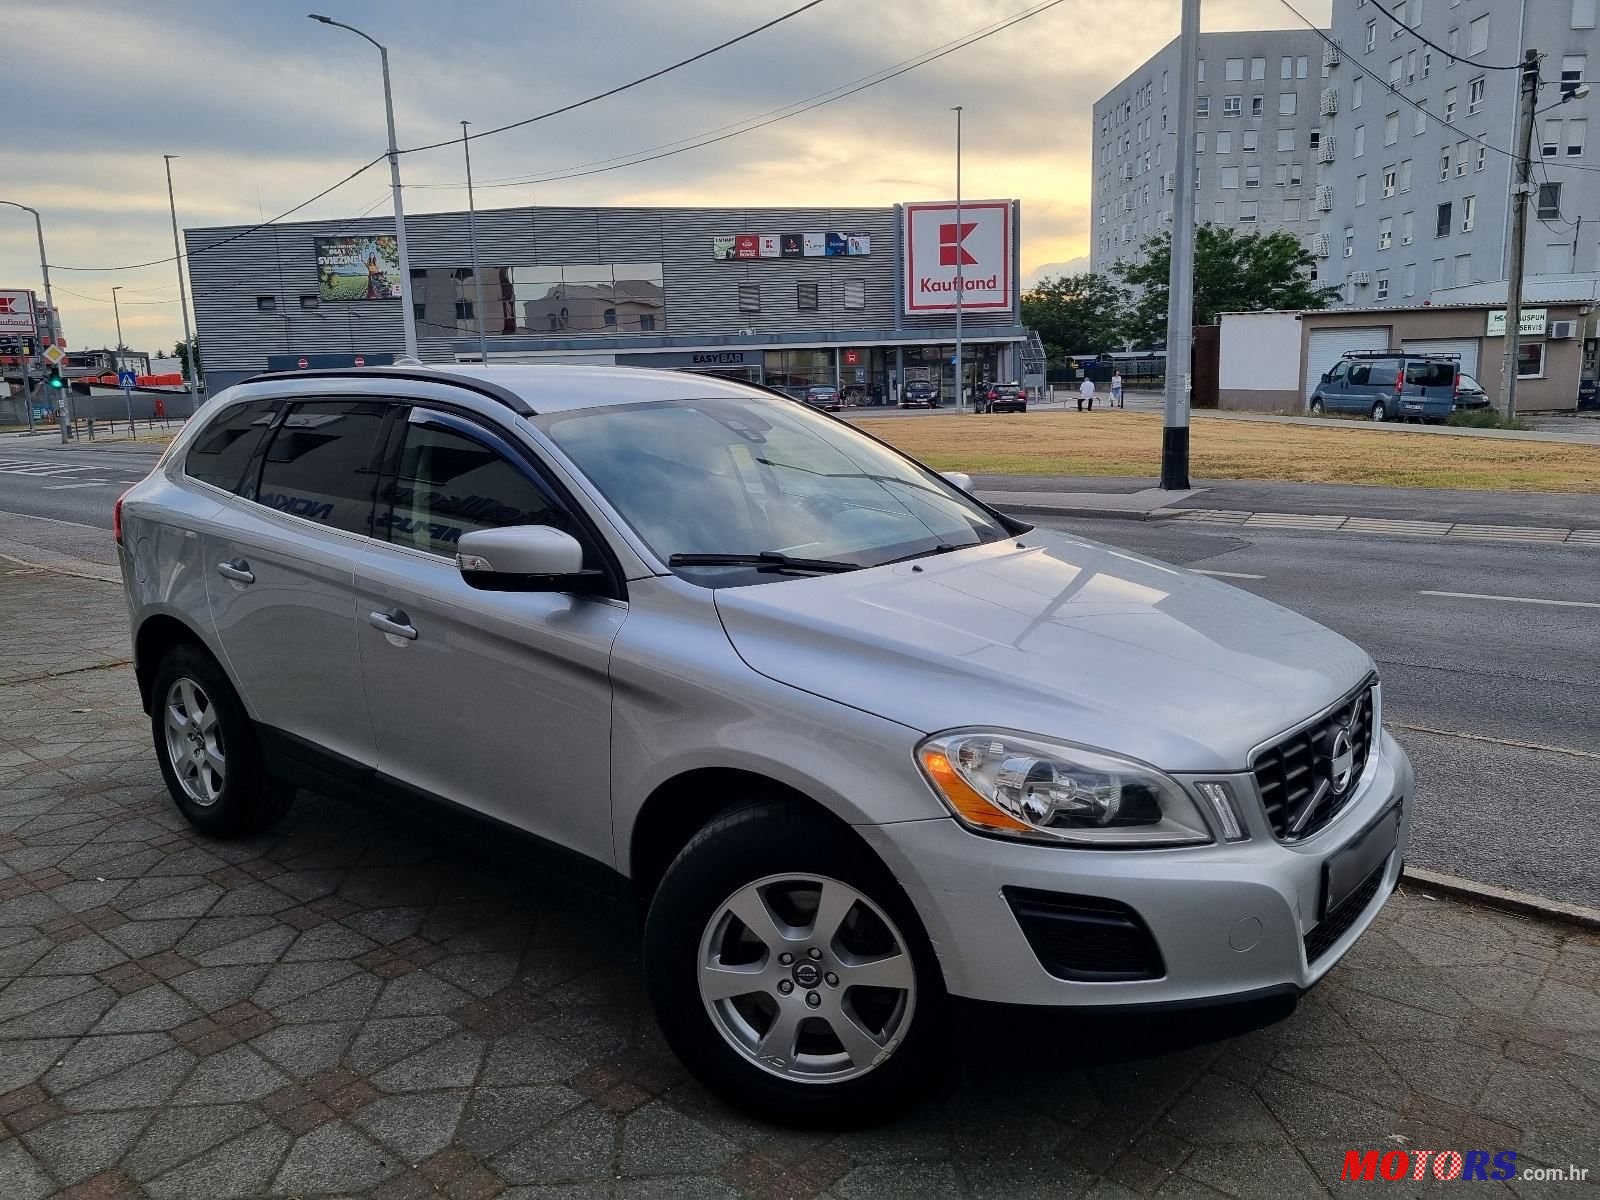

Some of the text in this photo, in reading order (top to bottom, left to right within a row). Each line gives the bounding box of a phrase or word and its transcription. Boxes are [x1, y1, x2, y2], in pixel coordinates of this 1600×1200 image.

[920, 275, 997, 293] Kaufland
[693, 353, 743, 364] EASY BAR
